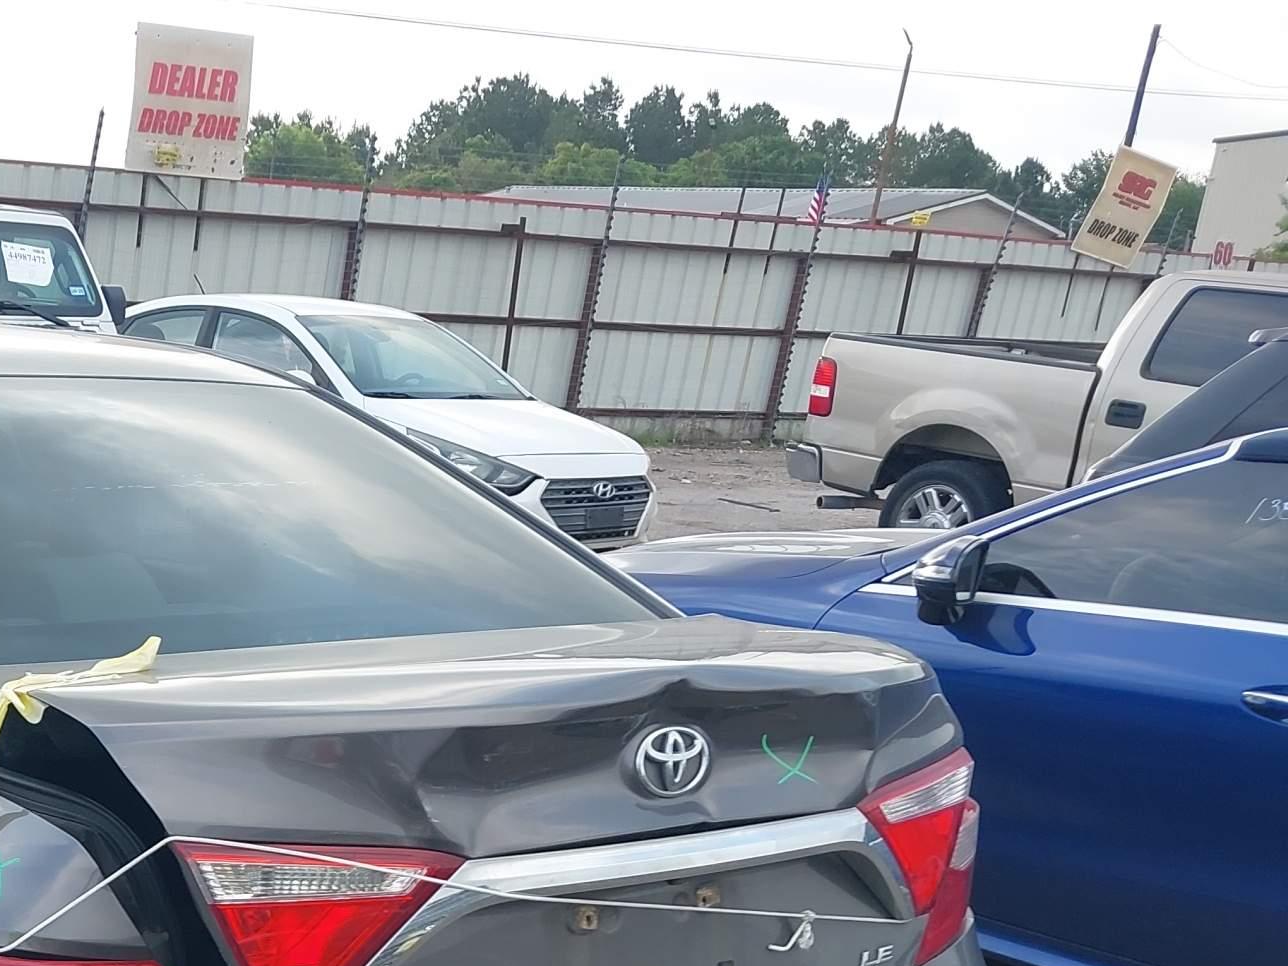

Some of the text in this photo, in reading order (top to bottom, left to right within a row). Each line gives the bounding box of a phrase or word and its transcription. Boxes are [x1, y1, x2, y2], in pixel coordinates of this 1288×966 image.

[148, 62, 238, 102] DEALER
[138, 108, 240, 141] DROP ZONE
[1087, 219, 1140, 248] DROP ZONE
[1214, 241, 1233, 265] 60
